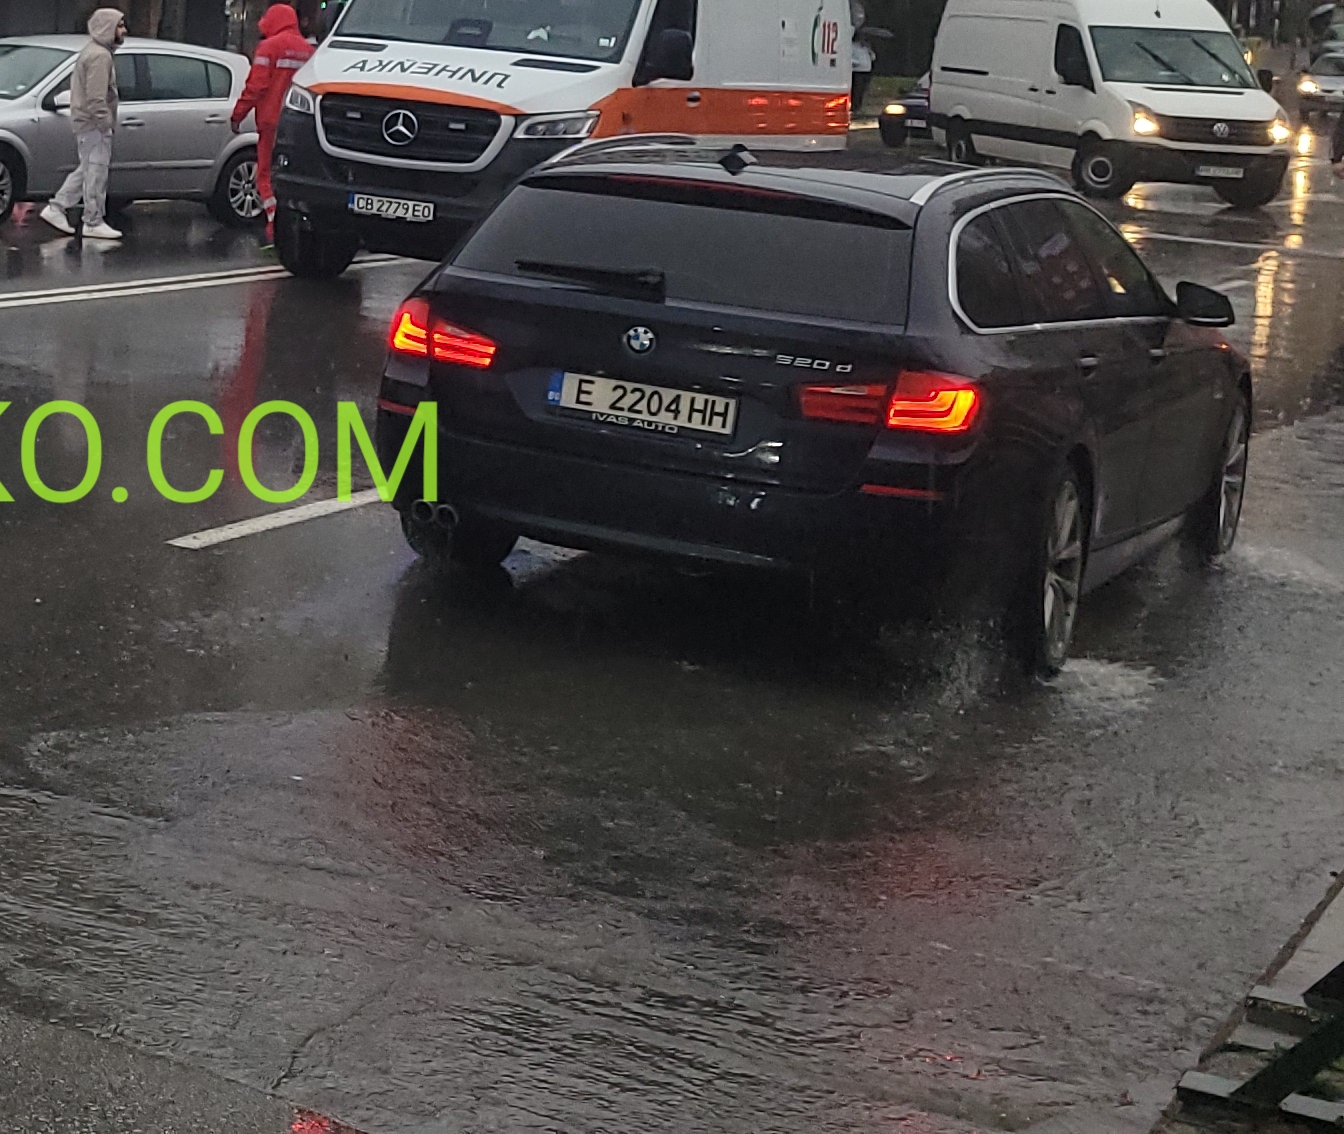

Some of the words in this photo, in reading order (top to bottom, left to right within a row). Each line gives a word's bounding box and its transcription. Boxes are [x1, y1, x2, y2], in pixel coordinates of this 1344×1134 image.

[821, 20, 839, 55] 112
[356, 196, 374, 211] CB
[376, 199, 410, 216] 2779
[412, 204, 432, 219] EO
[774, 354, 830, 370] 520
[835, 363, 853, 373] d
[574, 378, 596, 407] E
[608, 384, 682, 421] 2204
[686, 398, 731, 430] HH
[591, 412, 630, 426] IVAS
[631, 419, 679, 434] AUTO
